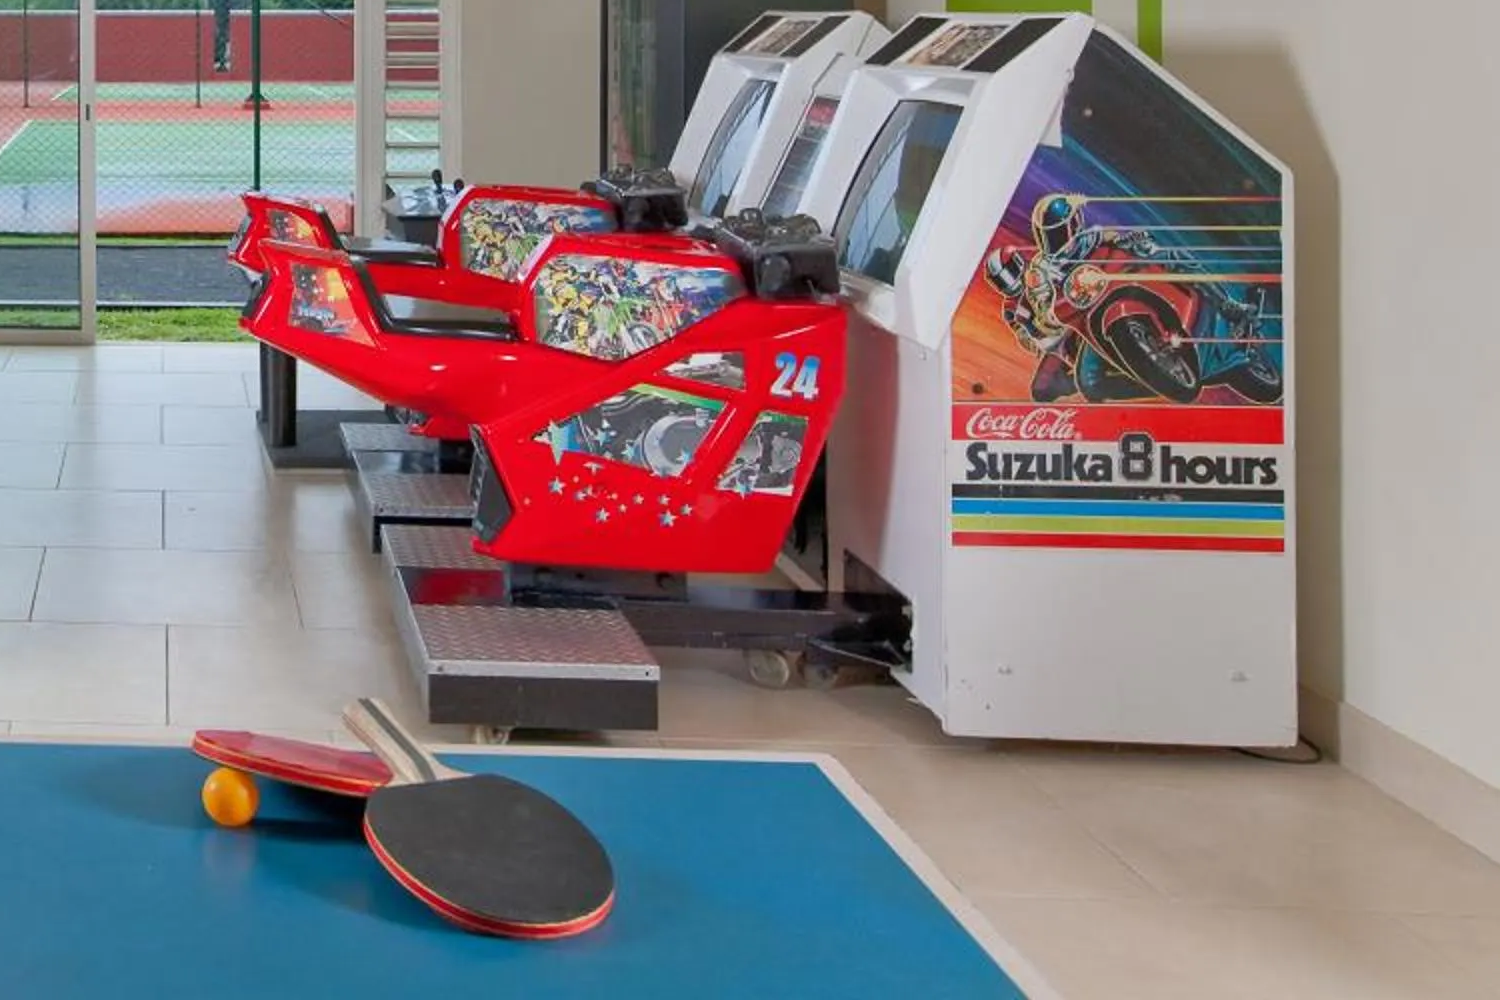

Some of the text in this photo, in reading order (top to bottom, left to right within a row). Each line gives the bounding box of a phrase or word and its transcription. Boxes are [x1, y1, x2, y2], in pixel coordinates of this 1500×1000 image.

[770, 351, 821, 400] 24
[966, 431, 1277, 485] Suzuka 8 hours
